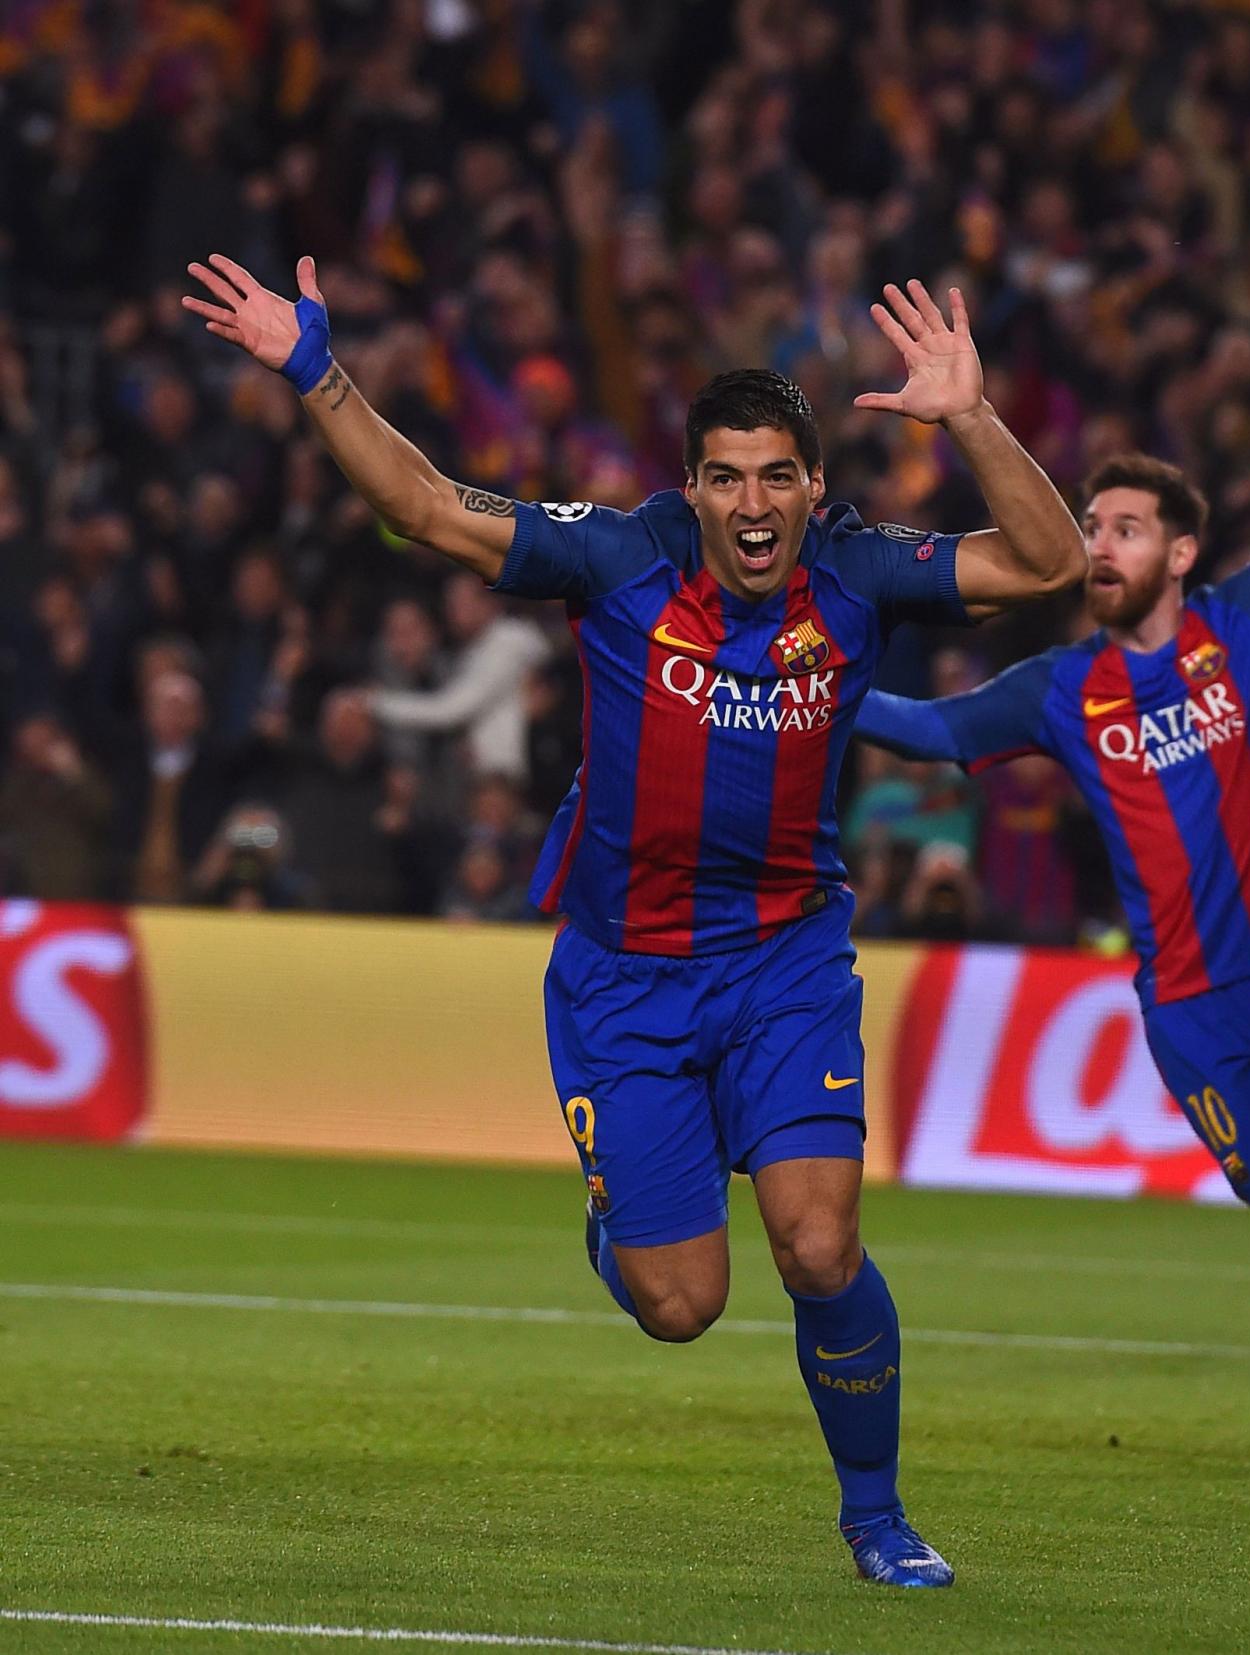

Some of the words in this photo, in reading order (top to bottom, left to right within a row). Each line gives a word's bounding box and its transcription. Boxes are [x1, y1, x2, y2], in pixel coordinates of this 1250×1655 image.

[661, 655, 836, 706] QATAR
[698, 703, 833, 733] AIRWAYS
[1098, 682, 1238, 763] QATAR
[1142, 713, 1247, 775] AIRWAYS
[565, 1096, 597, 1168] 9
[1187, 1086, 1237, 1152] 10
